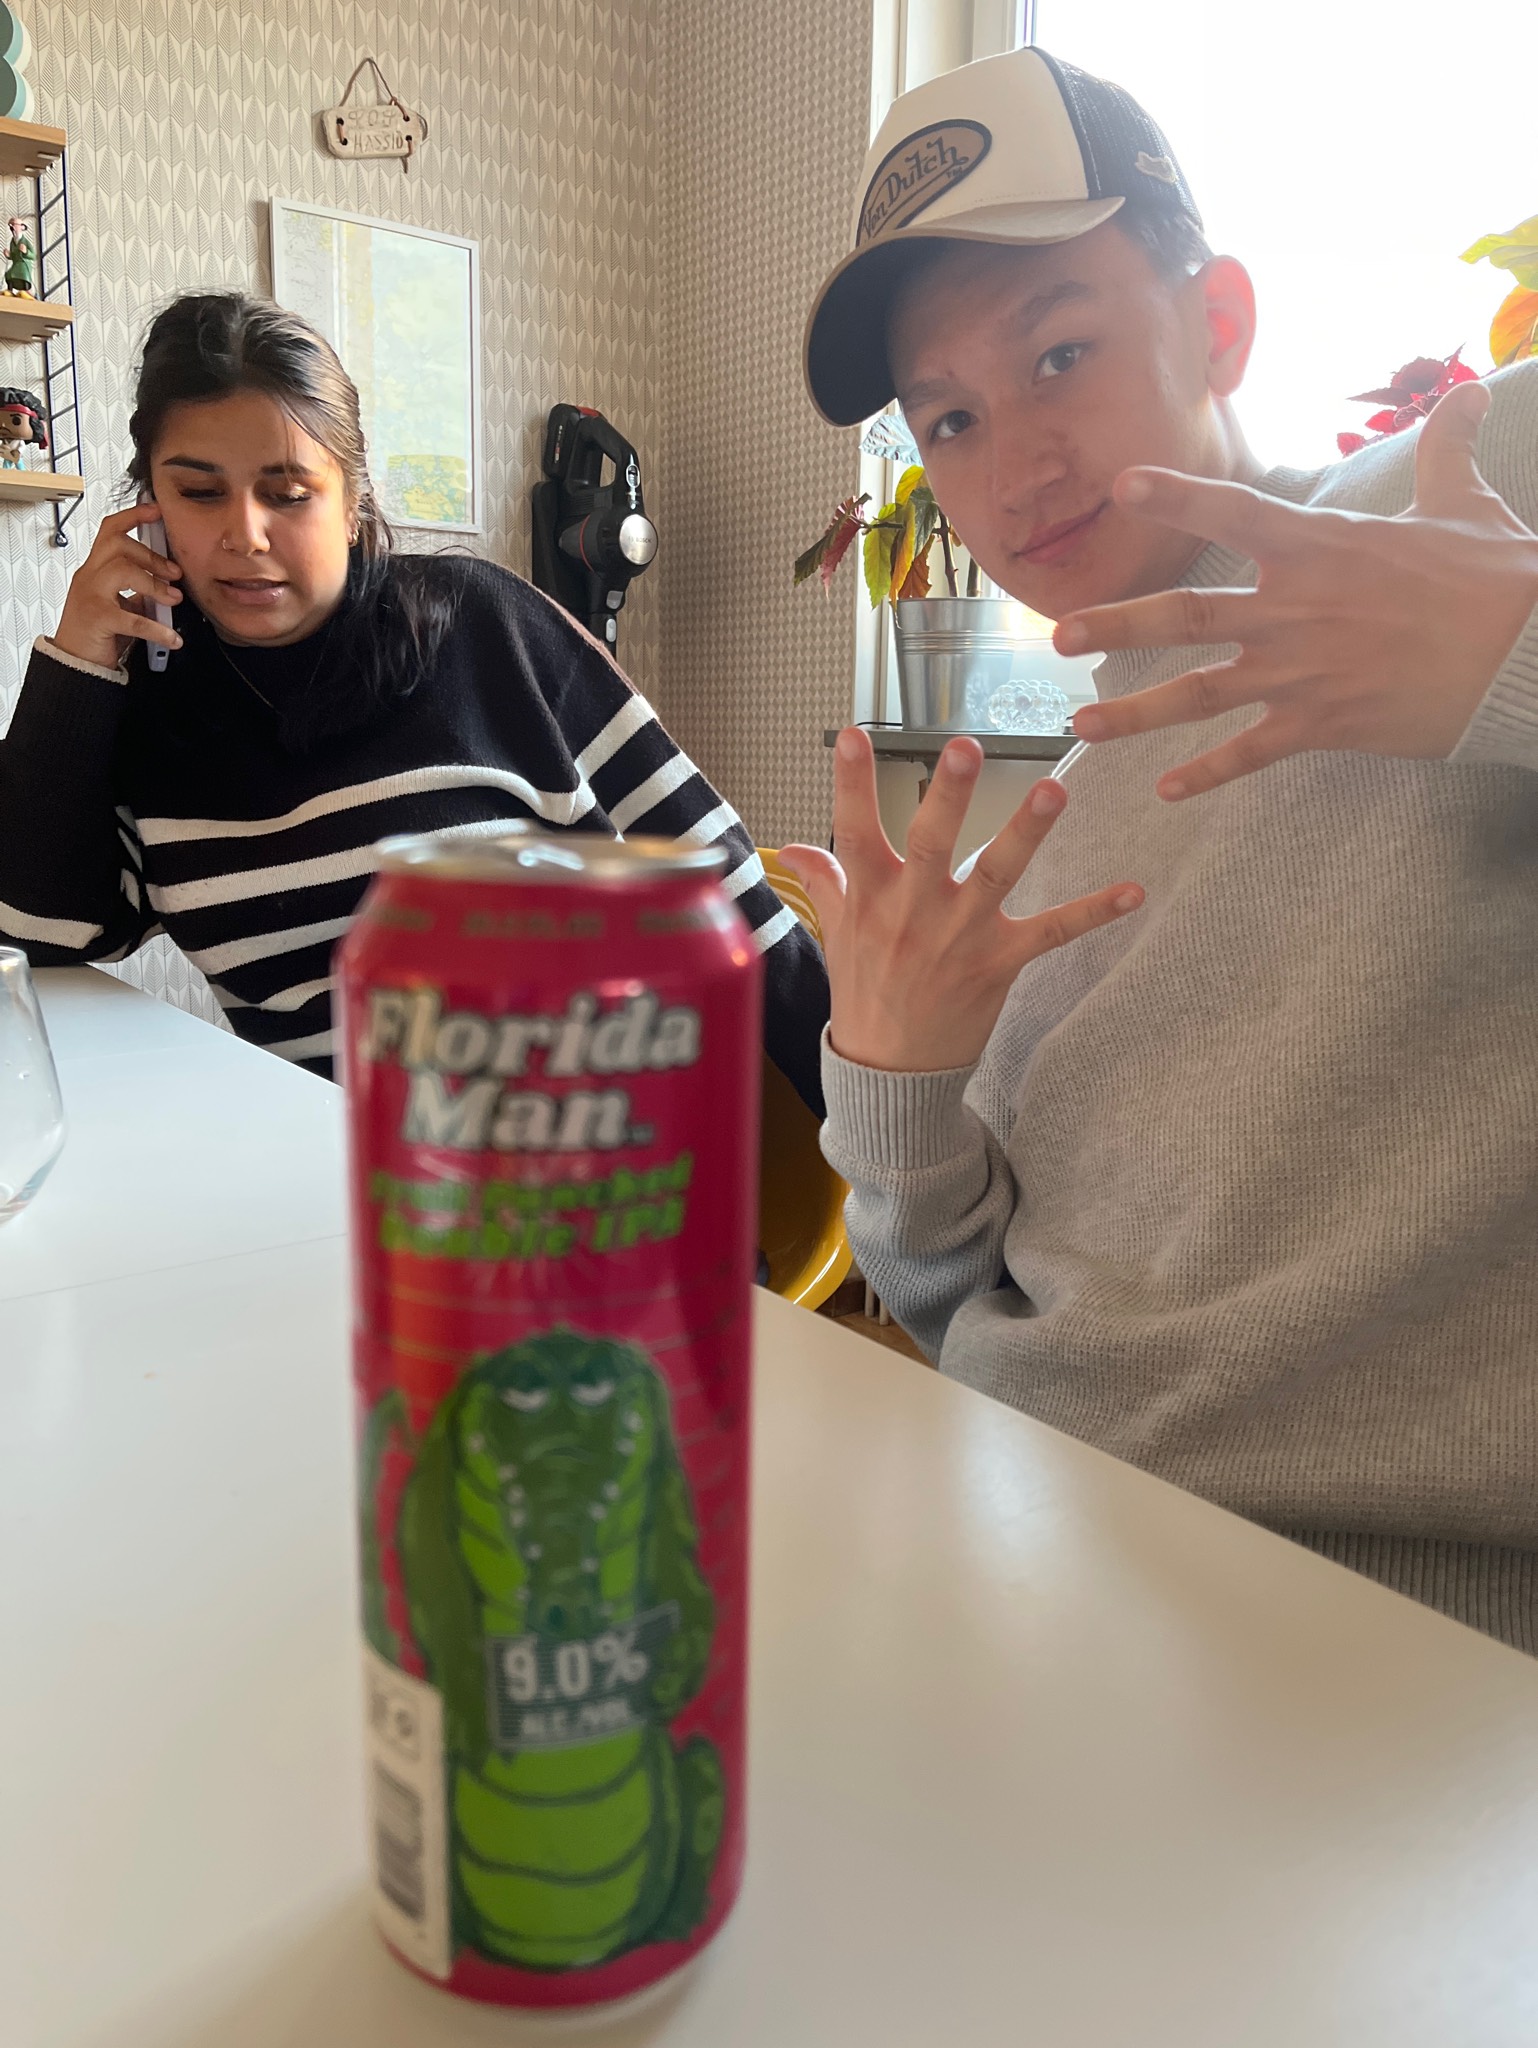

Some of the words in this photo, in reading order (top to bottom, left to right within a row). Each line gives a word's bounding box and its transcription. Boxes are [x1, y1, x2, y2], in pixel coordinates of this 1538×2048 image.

[884, 136, 970, 207] Dutch
[364, 986, 701, 1078] Florida
[505, 1630, 649, 1702] 9.0%
